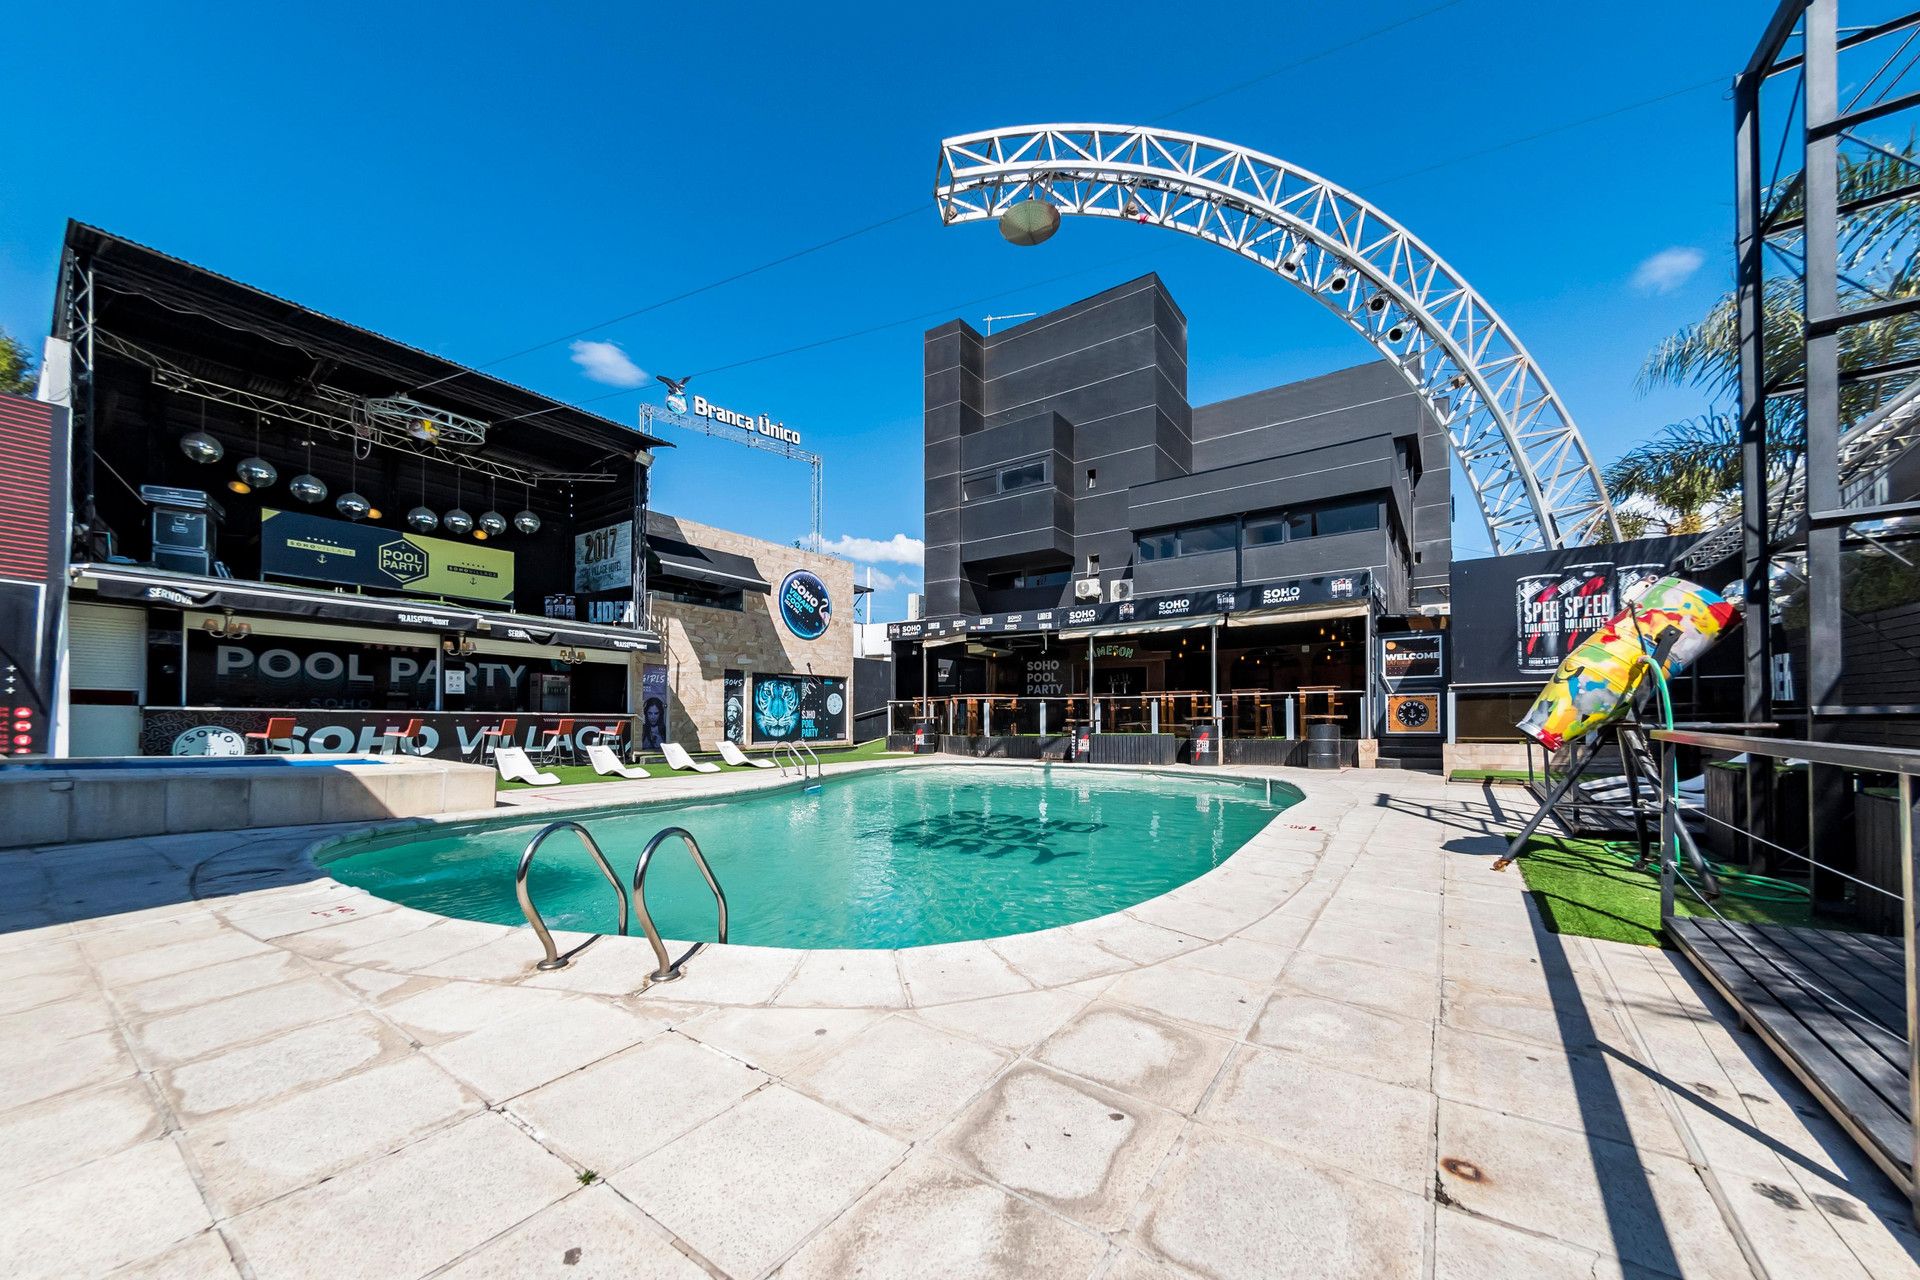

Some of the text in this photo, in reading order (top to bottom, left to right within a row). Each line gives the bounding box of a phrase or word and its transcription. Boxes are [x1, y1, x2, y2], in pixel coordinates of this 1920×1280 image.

[694, 395, 801, 445] Branca Único
[584, 527, 618, 565] 2017
[382, 549, 423, 564] POOL
[382, 559, 423, 573] PARTY
[791, 579, 819, 608] SOHO
[1263, 586, 1301, 599] SOHO
[786, 593, 803, 613] COOL
[789, 587, 815, 614] VERANO
[1158, 598, 1190, 610] SOHO
[1262, 595, 1300, 605] POOLPARTY
[1564, 595, 1610, 618] SPEED
[1069, 609, 1096, 620] SOHO
[1158, 607, 1190, 615] POOLPARTY
[901, 624, 922, 633] SOHO
[1385, 651, 1440, 661] WELCOME
[217, 645, 375, 681] POOL
[390, 656, 526, 688] PARTY
[1027, 660, 1060, 671] SOHO
[1027, 672, 1057, 682] POOL
[1027, 684, 1064, 694] PARTY
[185, 729, 235, 744] SOHO
[801, 728, 819, 738] PARTY
